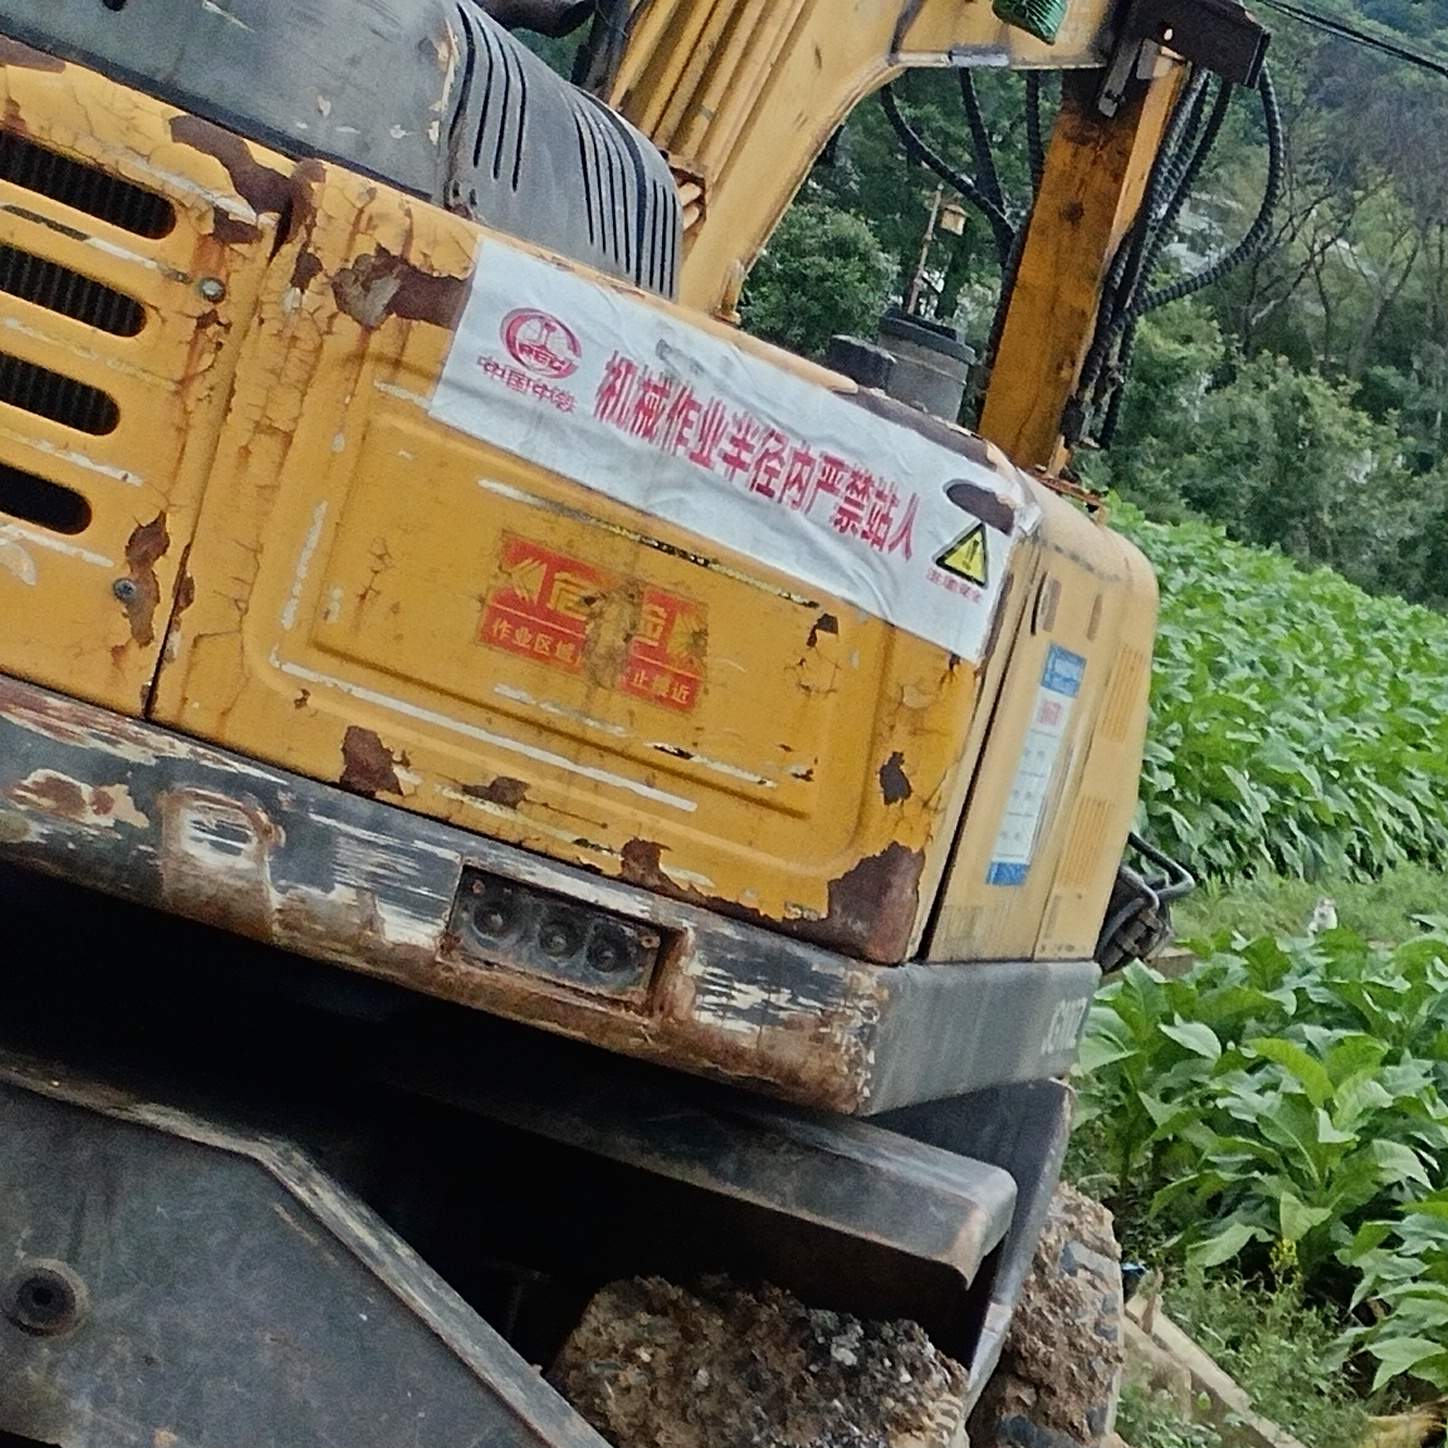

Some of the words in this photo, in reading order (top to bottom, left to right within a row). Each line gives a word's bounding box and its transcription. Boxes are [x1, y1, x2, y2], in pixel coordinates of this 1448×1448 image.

[593, 350, 919, 562] 机械作业半径内严禁站人
